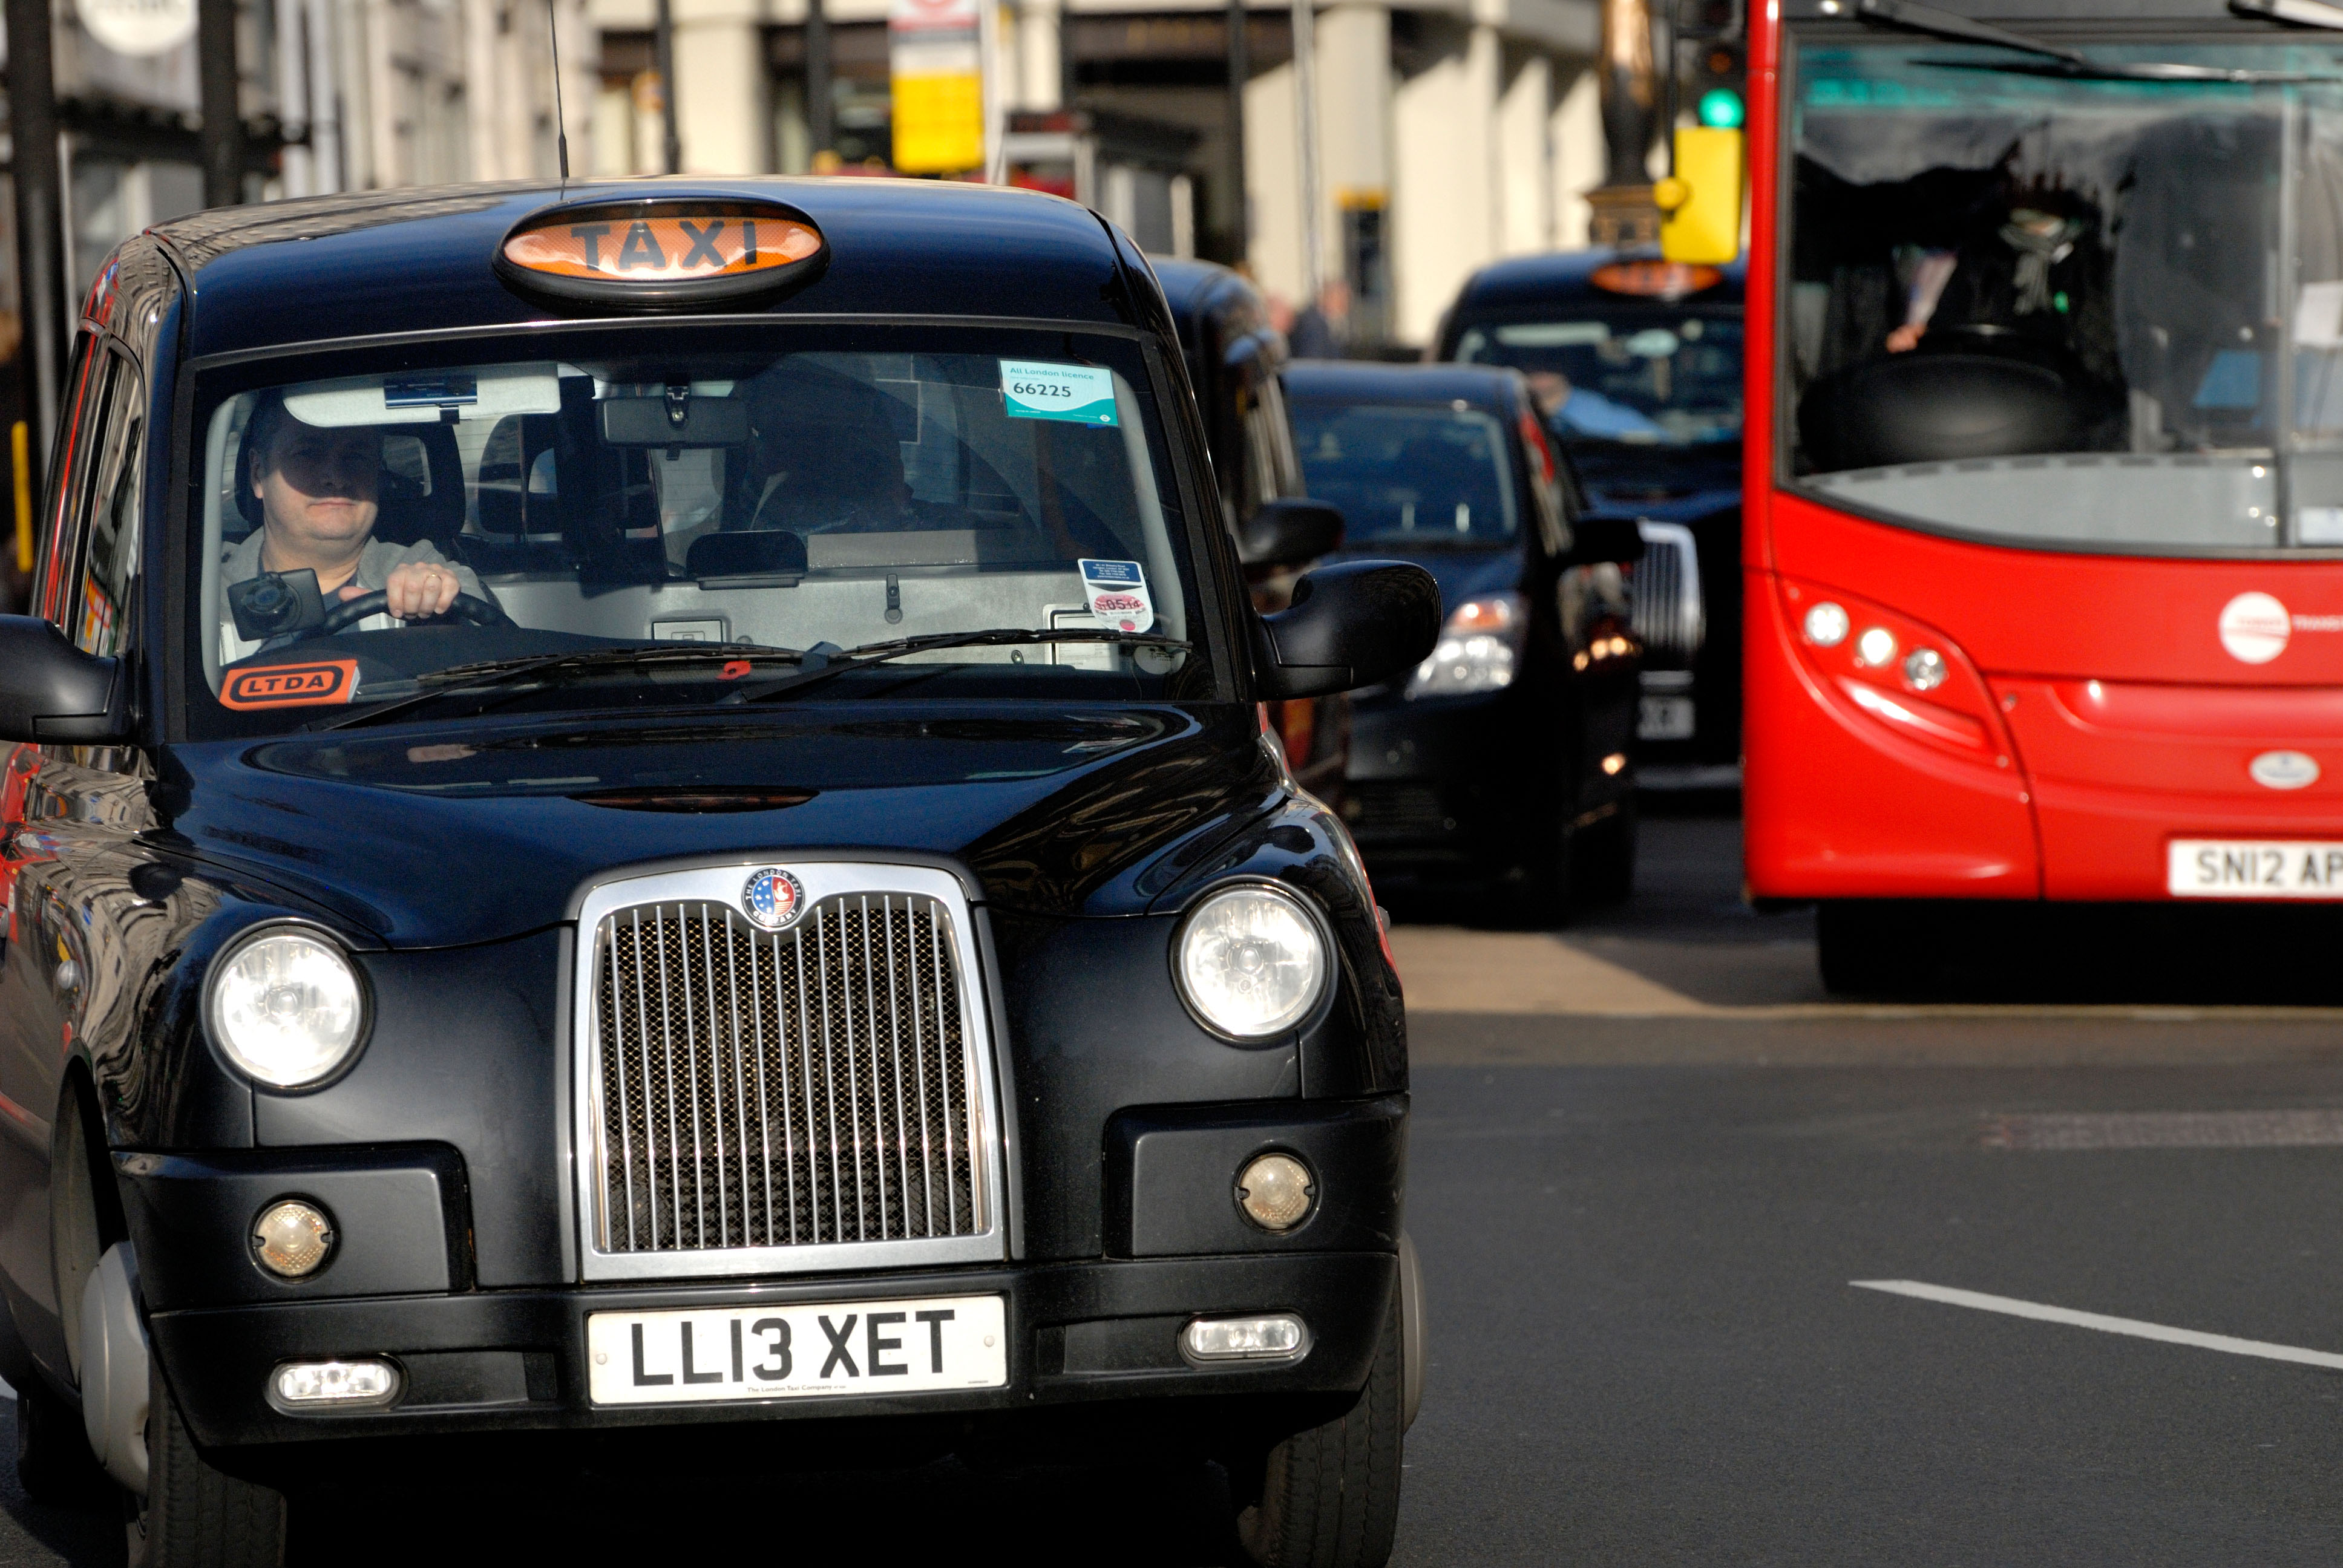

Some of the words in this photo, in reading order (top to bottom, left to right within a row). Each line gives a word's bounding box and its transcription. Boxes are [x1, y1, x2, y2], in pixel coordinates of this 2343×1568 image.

[571, 220, 757, 270] TAXI
[1025, 368, 1059, 376] London
[1062, 370, 1094, 380] licence
[1013, 382, 1071, 397] 66225
[247, 675, 324, 693] LTDA
[2197, 849, 2286, 884] SN12
[752, 869, 788, 882] LONDON
[790, 877, 801, 897] TAXI
[631, 1318, 793, 1387] LL13
[818, 1309, 955, 1379] XET
